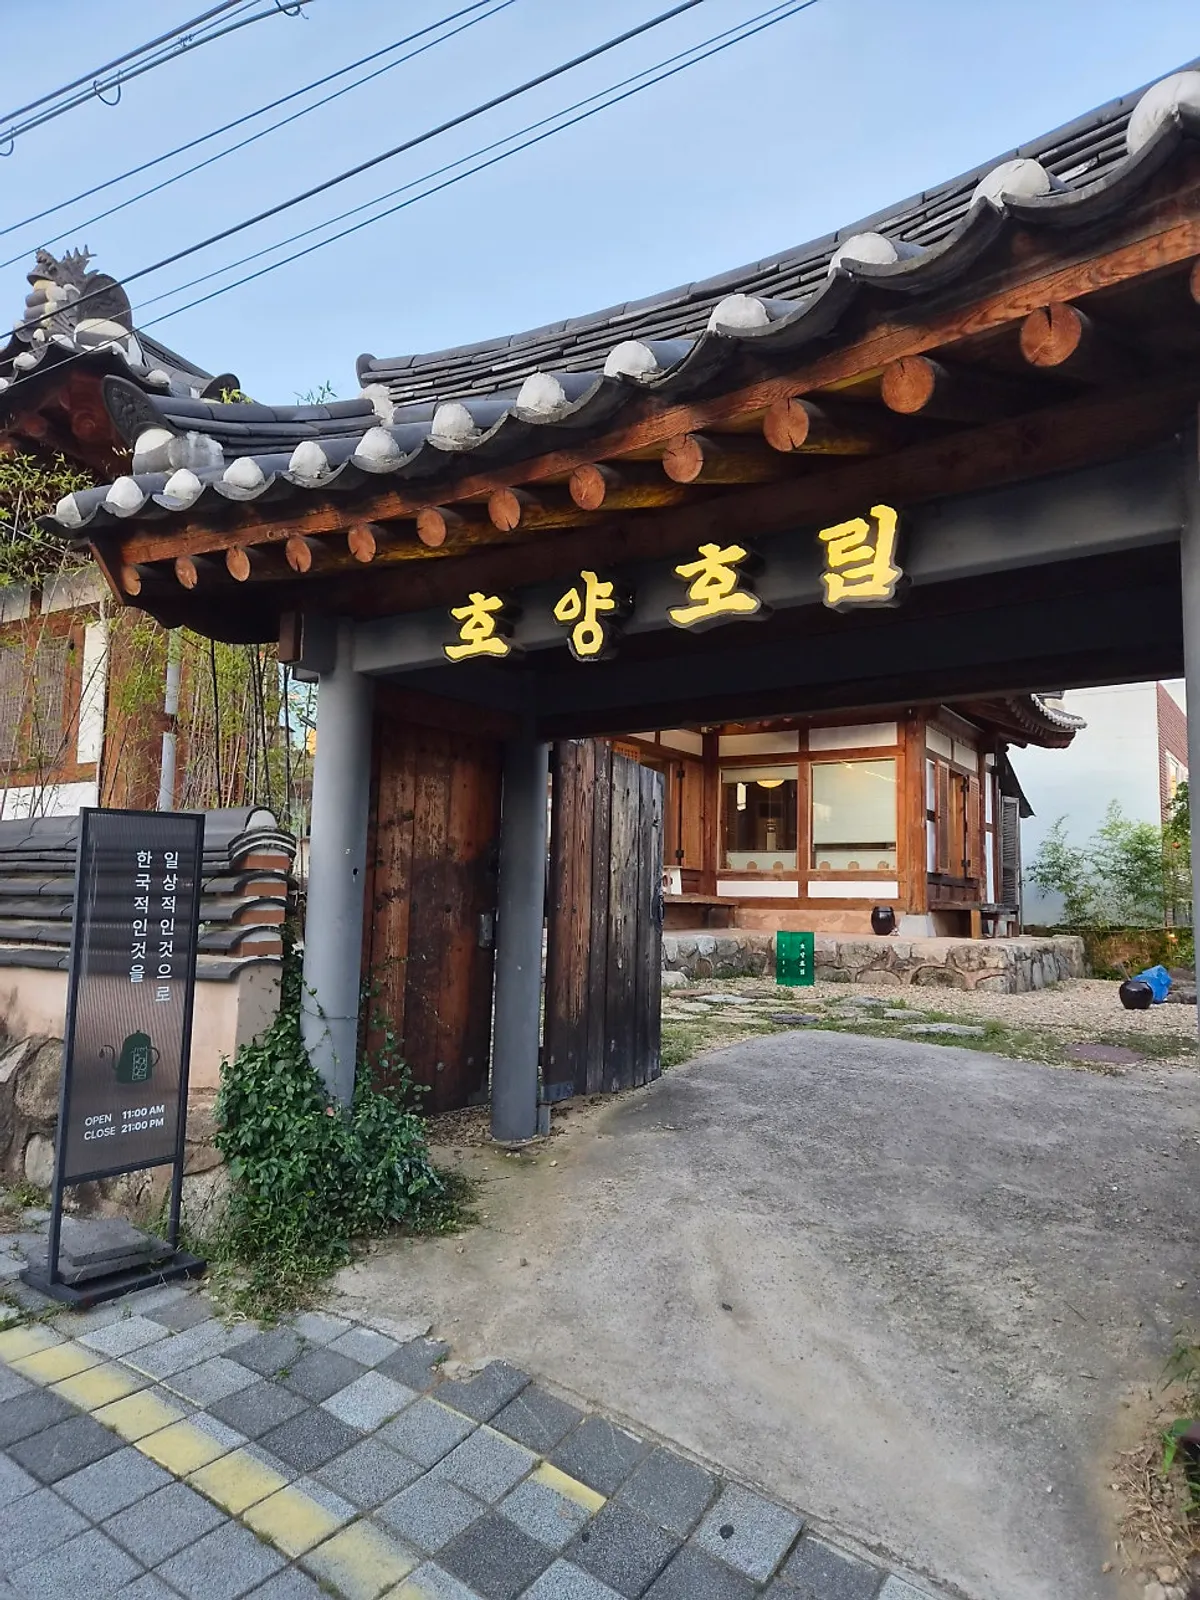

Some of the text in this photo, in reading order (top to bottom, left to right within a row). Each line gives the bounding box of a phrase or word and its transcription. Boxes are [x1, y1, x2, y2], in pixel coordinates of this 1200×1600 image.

[444, 503, 899, 659] 호양호림
[84, 1104, 165, 1127] OPEN 11:00 AM
[83, 1117, 164, 1141] CLOSE 21:00 PM
